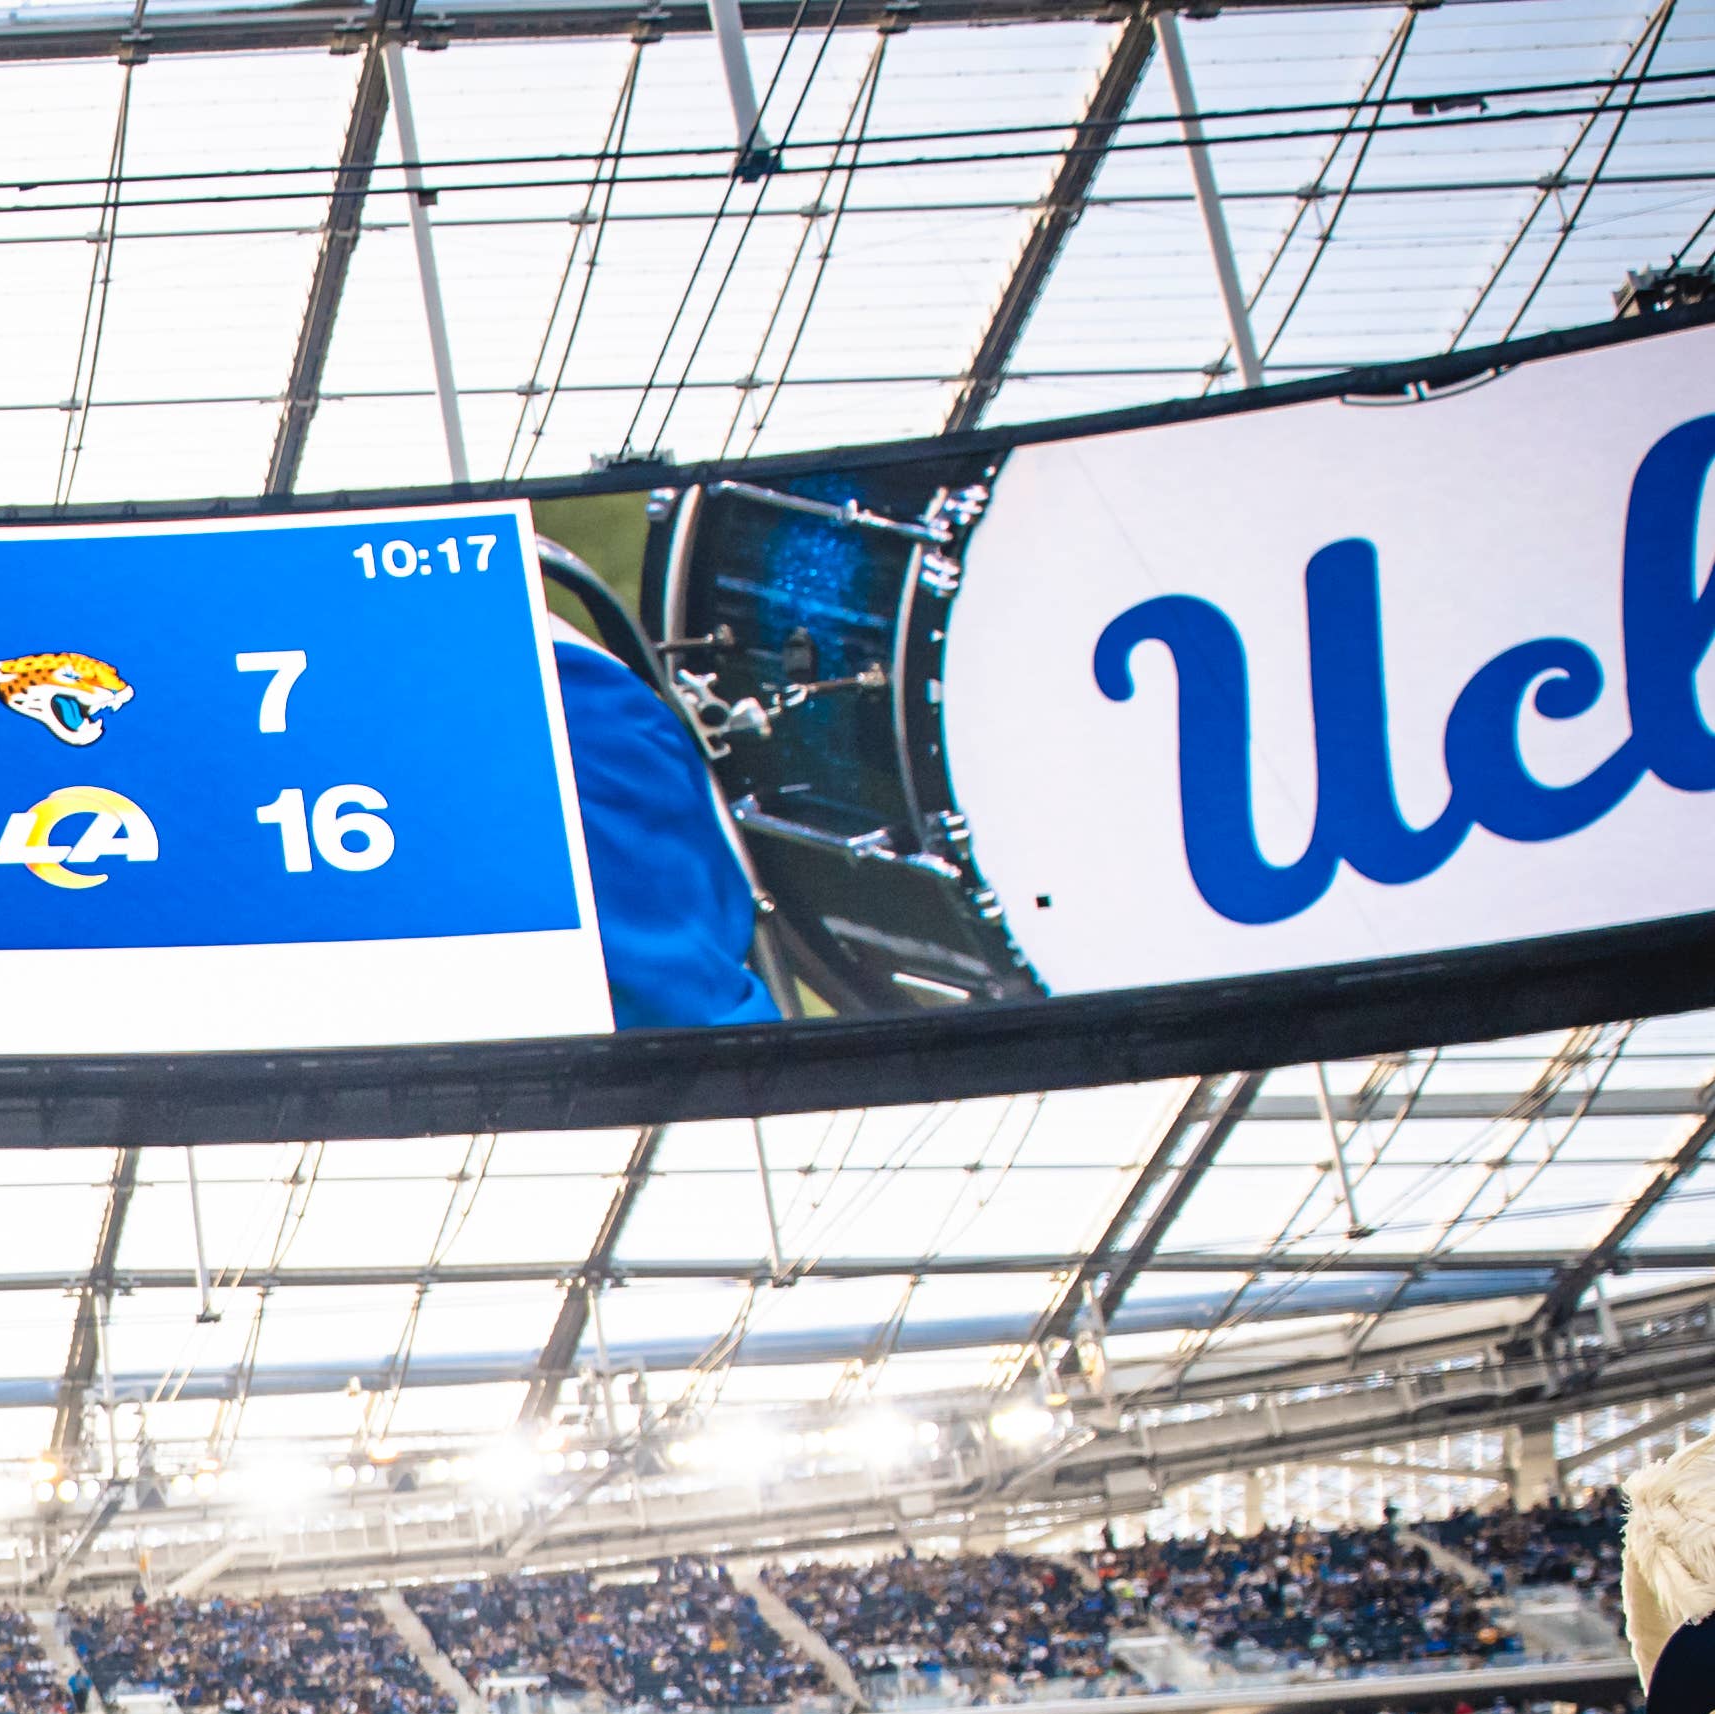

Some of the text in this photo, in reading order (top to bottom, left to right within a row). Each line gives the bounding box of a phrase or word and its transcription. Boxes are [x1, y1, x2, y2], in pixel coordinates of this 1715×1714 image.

[353, 535, 497, 579] 10:17
[236, 650, 307, 733] 7
[256, 784, 395, 872] 16
